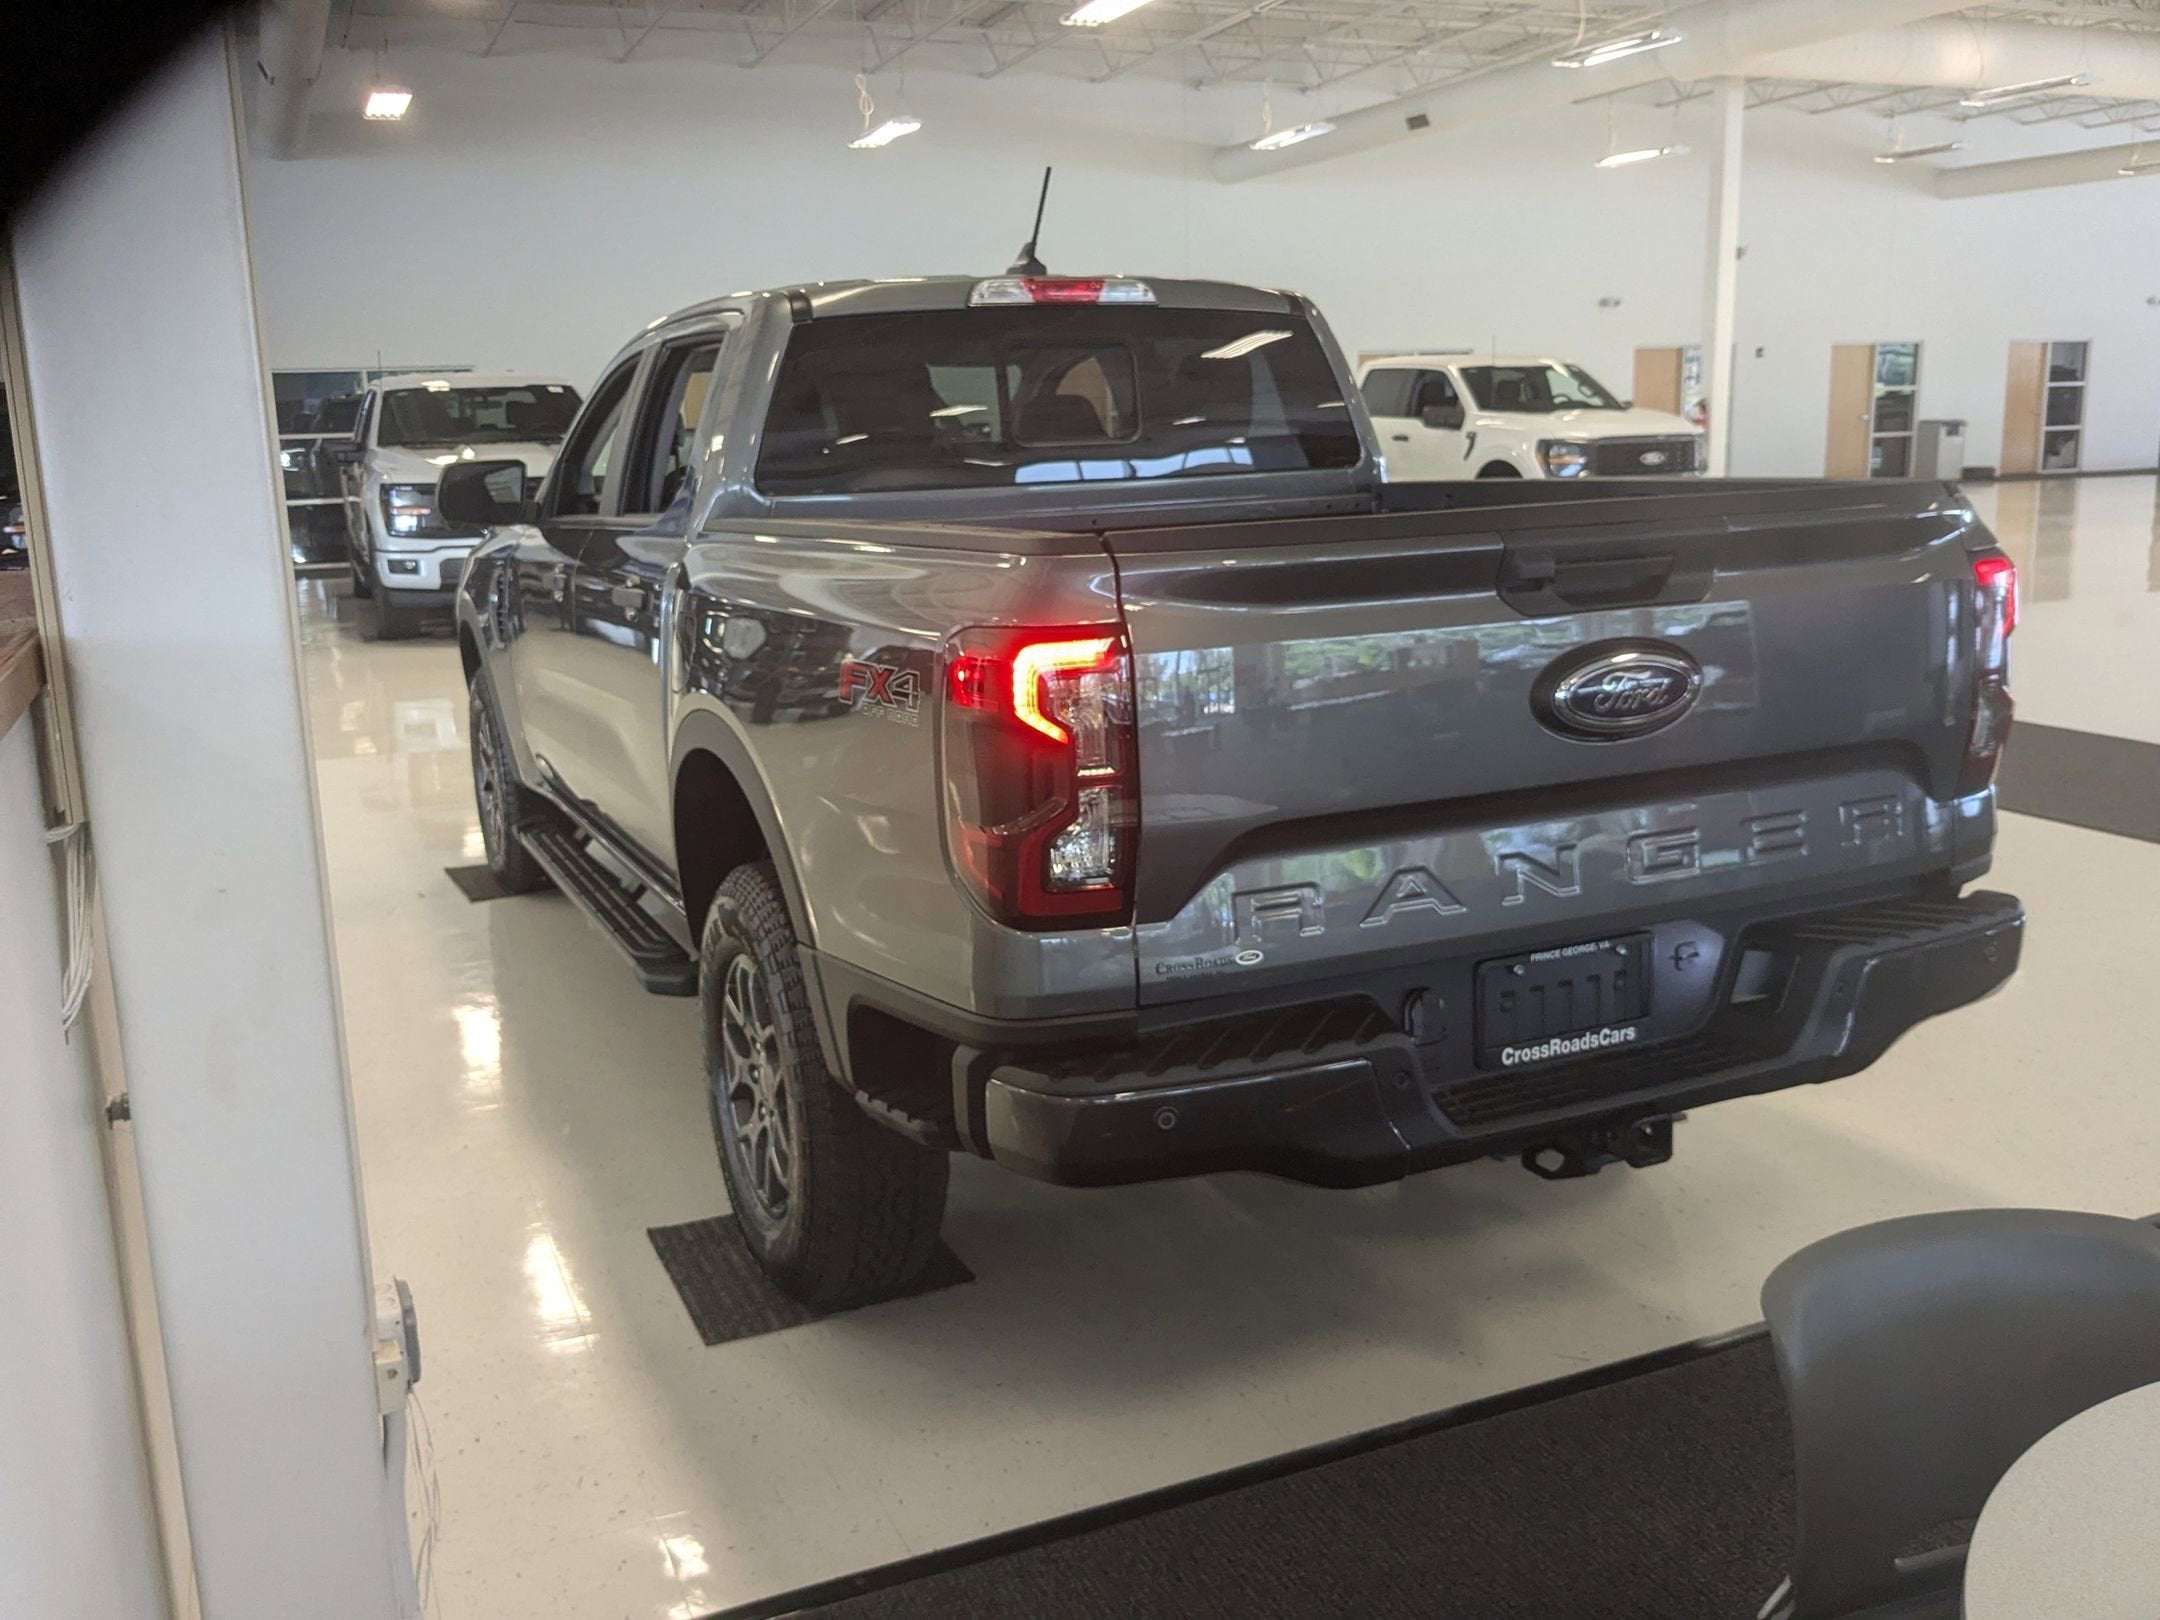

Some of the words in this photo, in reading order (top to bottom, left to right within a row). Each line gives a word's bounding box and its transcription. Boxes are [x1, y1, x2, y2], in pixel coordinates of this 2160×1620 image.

[838, 659, 920, 713] FX4
[1592, 671, 1671, 713] Ford
[1231, 795, 1902, 946] RANGER
[1530, 949, 1561, 963] PRINCE
[1501, 1026, 1636, 1066] CrossRoadsCars
